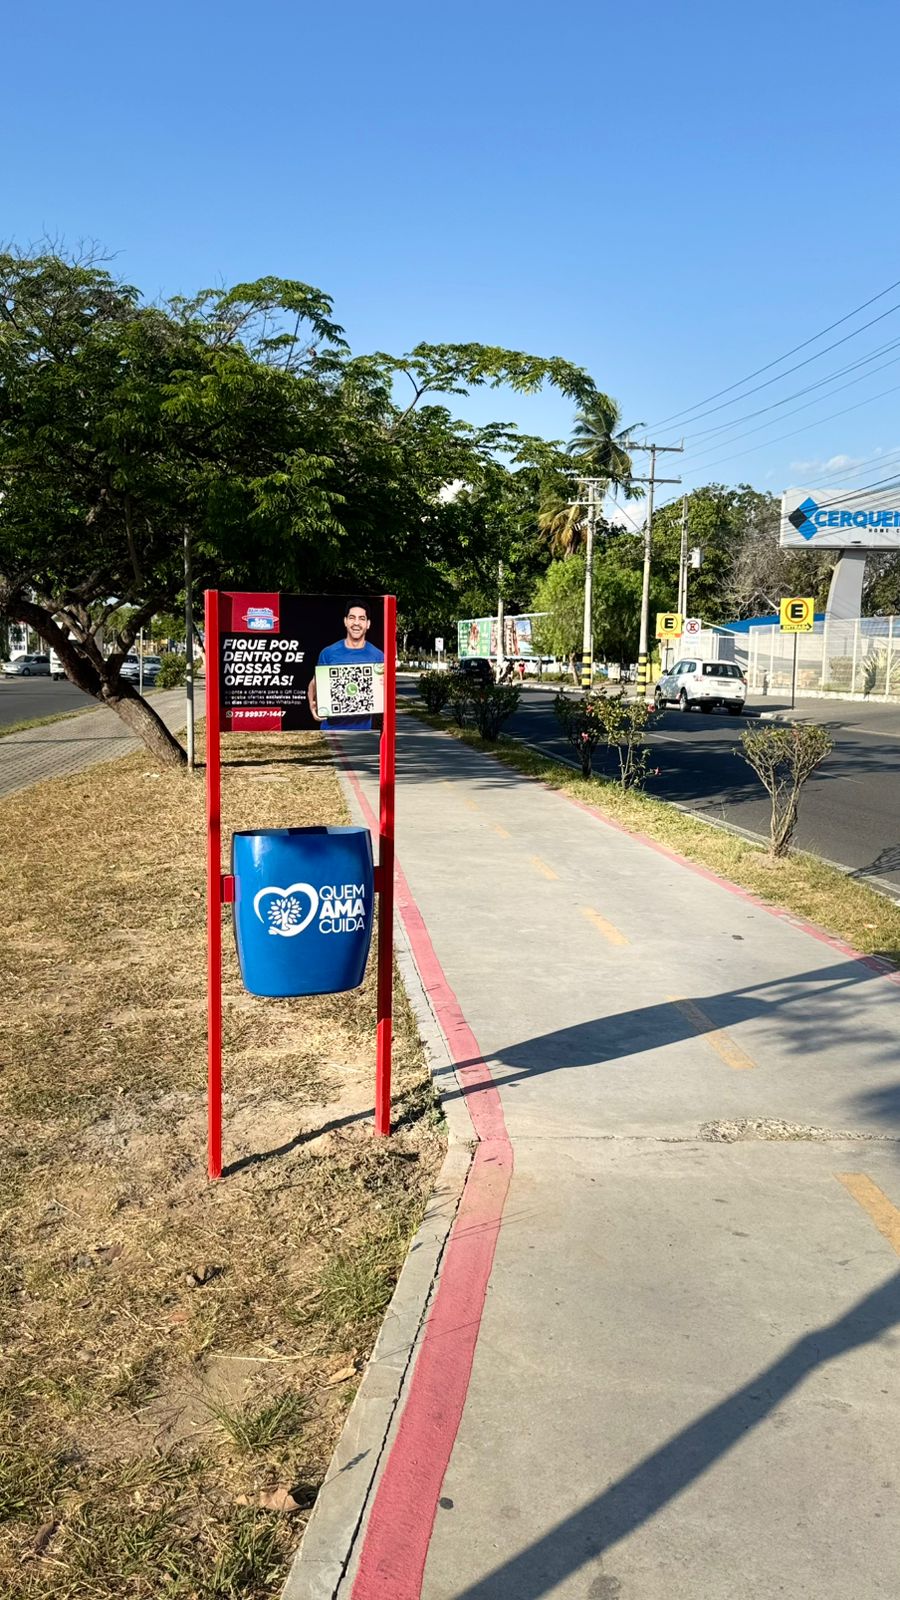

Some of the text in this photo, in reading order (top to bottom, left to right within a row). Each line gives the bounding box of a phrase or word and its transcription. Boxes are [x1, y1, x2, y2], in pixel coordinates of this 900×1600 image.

[791, 604, 803, 618] E
[664, 618, 674, 628] E
[223, 638, 299, 651] FIQUE POR
[223, 651, 305, 662] DENTRO DE
[223, 663, 281, 674] NOSSAS
[224, 675, 294, 686] OFERTAS!
[234, 710, 244, 718] 75
[319, 883, 365, 900] QUEM
[319, 898, 366, 919] AMA
[319, 916, 365, 934] CUIDA
